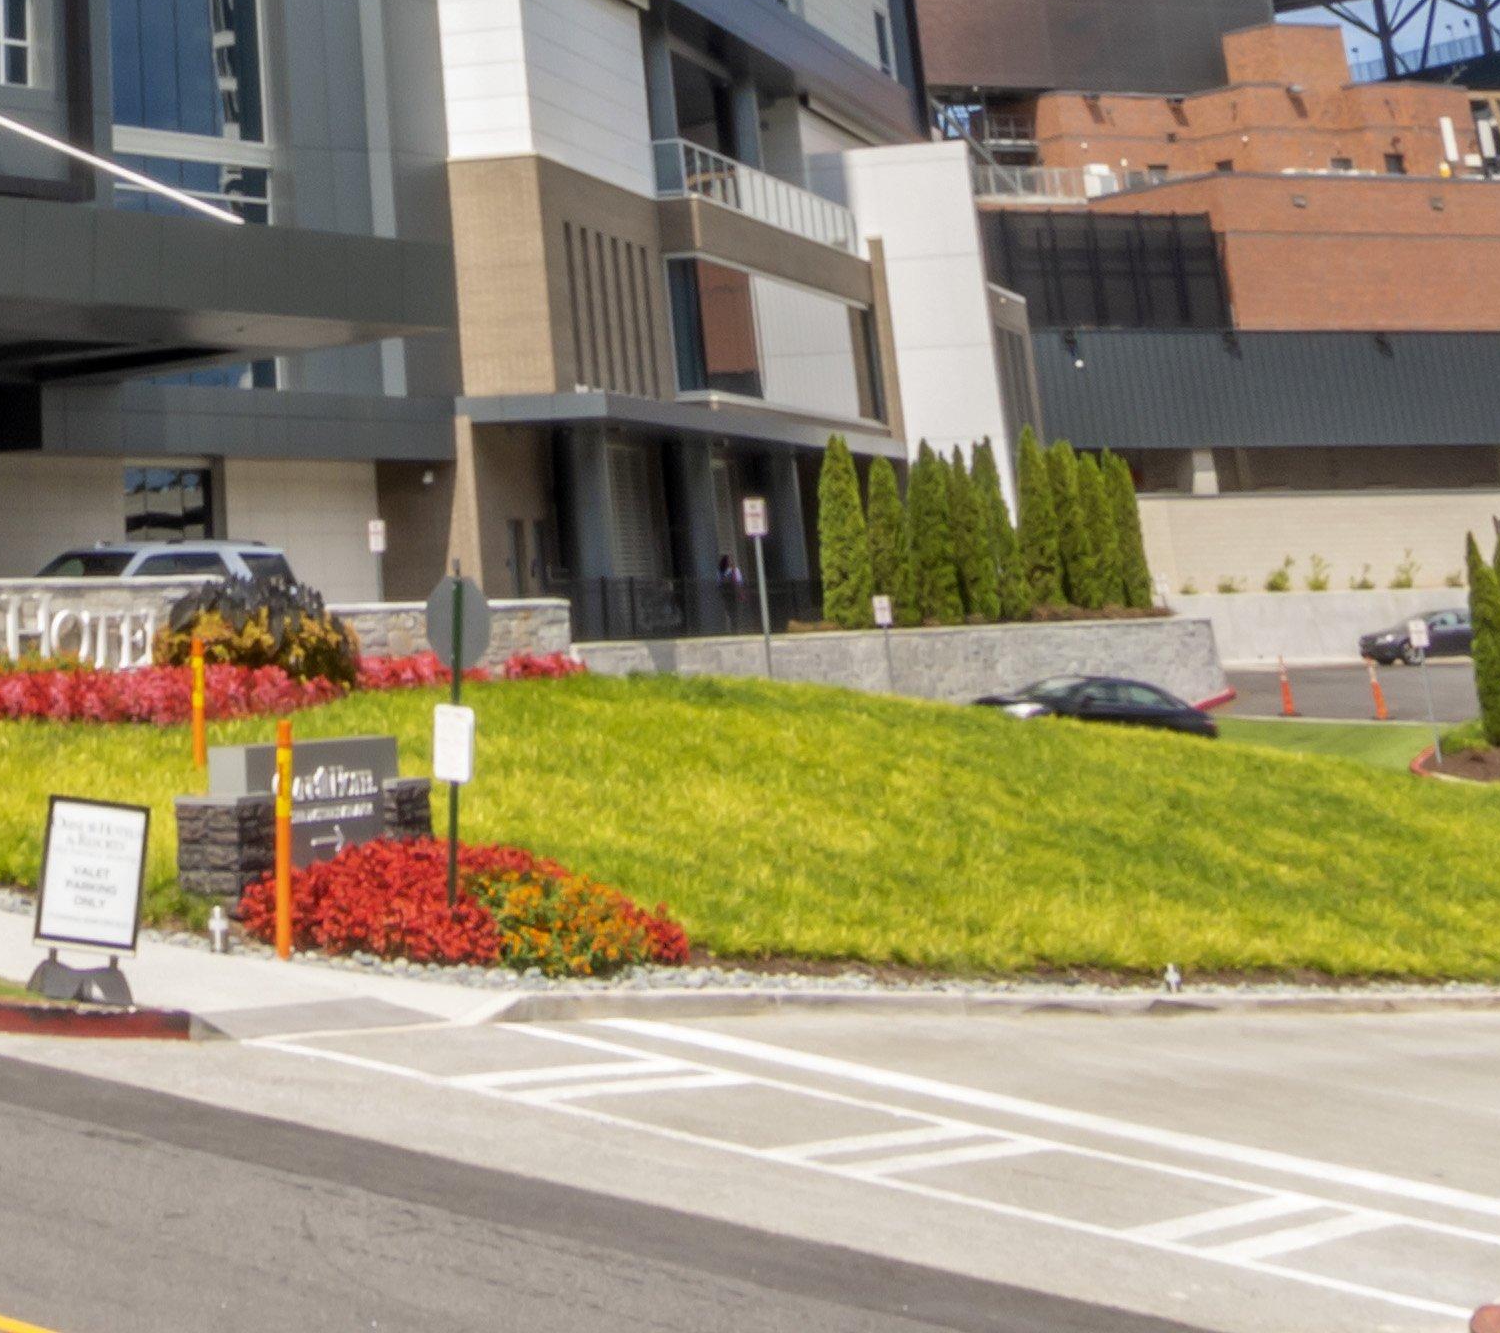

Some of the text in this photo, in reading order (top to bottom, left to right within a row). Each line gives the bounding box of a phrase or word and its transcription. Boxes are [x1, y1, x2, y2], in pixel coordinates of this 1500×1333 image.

[73, 865, 110, 879] VALET
[65, 878, 118, 897] PARKING
[73, 895, 106, 909] ONLY
